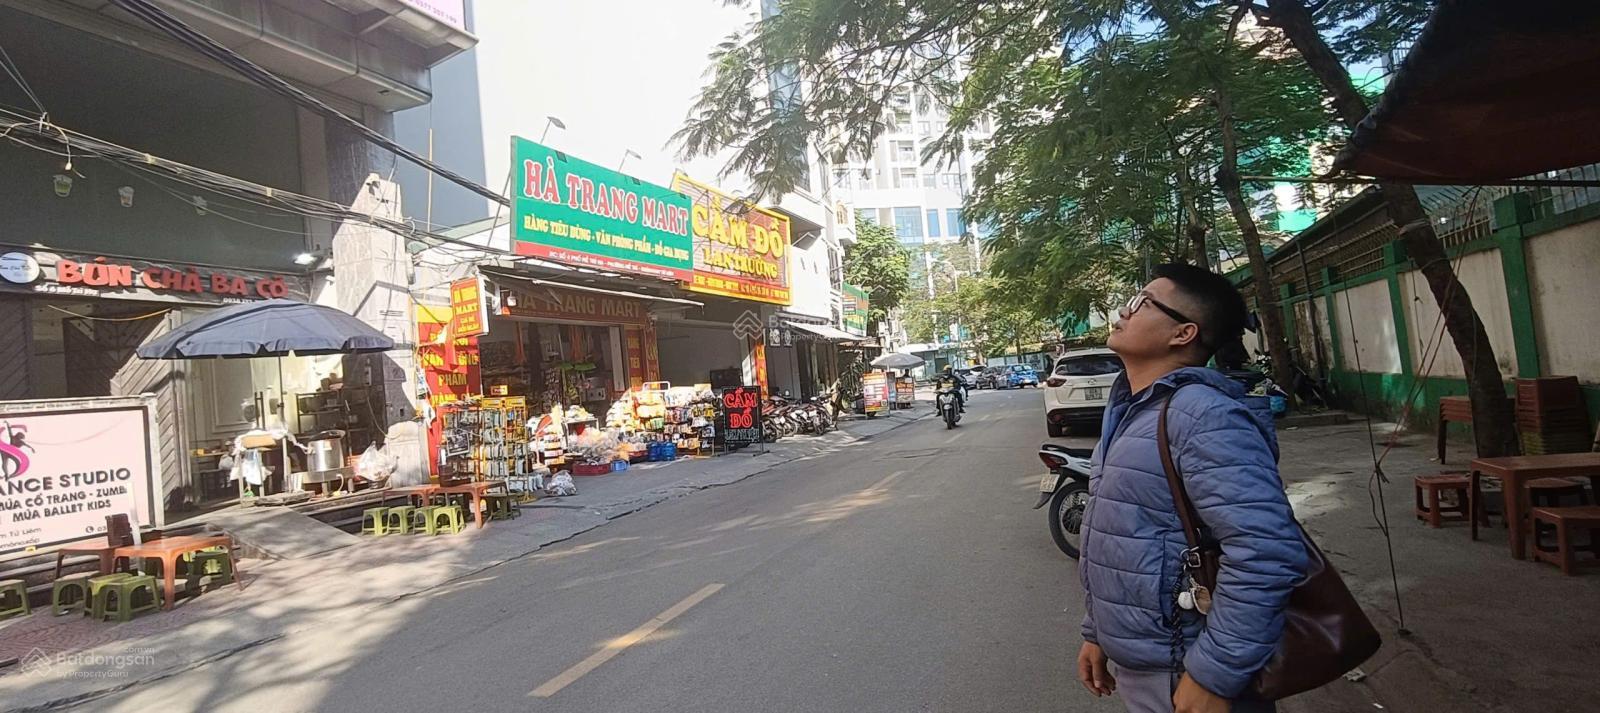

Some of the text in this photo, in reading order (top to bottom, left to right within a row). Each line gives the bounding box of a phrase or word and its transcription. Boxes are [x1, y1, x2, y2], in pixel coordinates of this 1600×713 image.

[524, 156, 688, 236] HÀ TRANG MART
[692, 196, 784, 258] CẦM ĐỒ
[56, 256, 132, 287] BÚN
[210, 272, 248, 296] BA
[601, 300, 641, 318] MART
[59, 468, 131, 488] STUDIO
[46, 490, 87, 505] TRANG
[96, 485, 127, 498] ZUMB
[12, 499, 111, 523] MÚA BALLET KIDS
